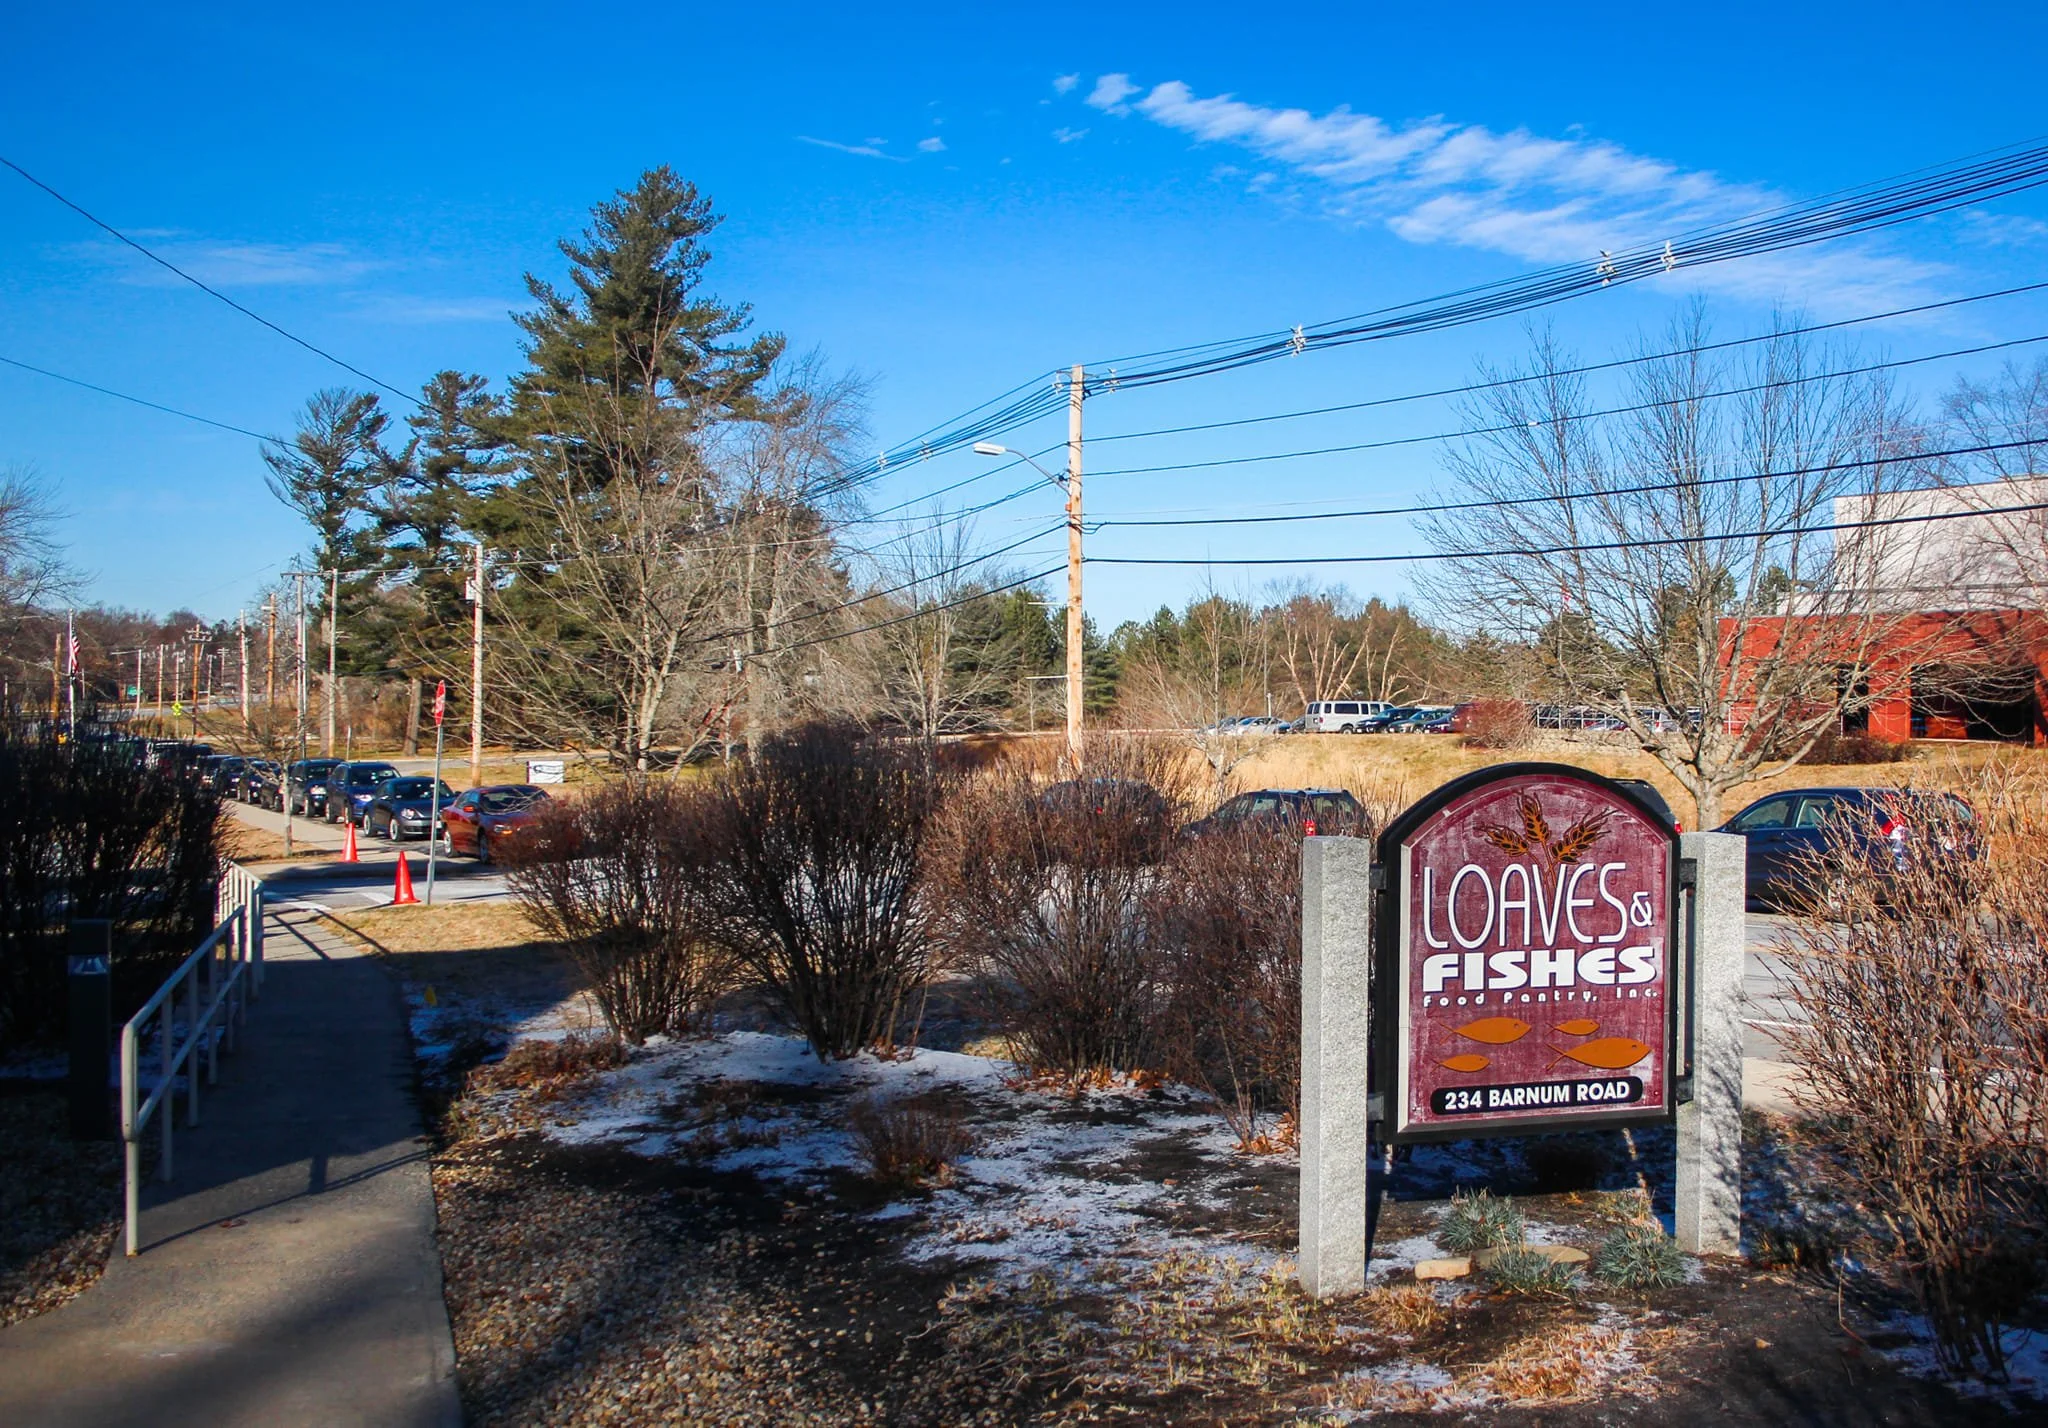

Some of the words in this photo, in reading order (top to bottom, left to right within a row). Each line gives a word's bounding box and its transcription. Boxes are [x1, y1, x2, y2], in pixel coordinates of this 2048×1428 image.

[1423, 862, 1628, 949] LOAVES
[1630, 891, 1653, 928] &
[1422, 946, 1657, 992] FISHES
[1423, 992, 1485, 1008] Food
[1503, 990, 1598, 1004] Pantry,
[1616, 987, 1658, 999] Inc.
[1445, 1090, 1482, 1110] 234
[1488, 1085, 1570, 1108] BARNUM
[1577, 1081, 1630, 1101] ROAD
